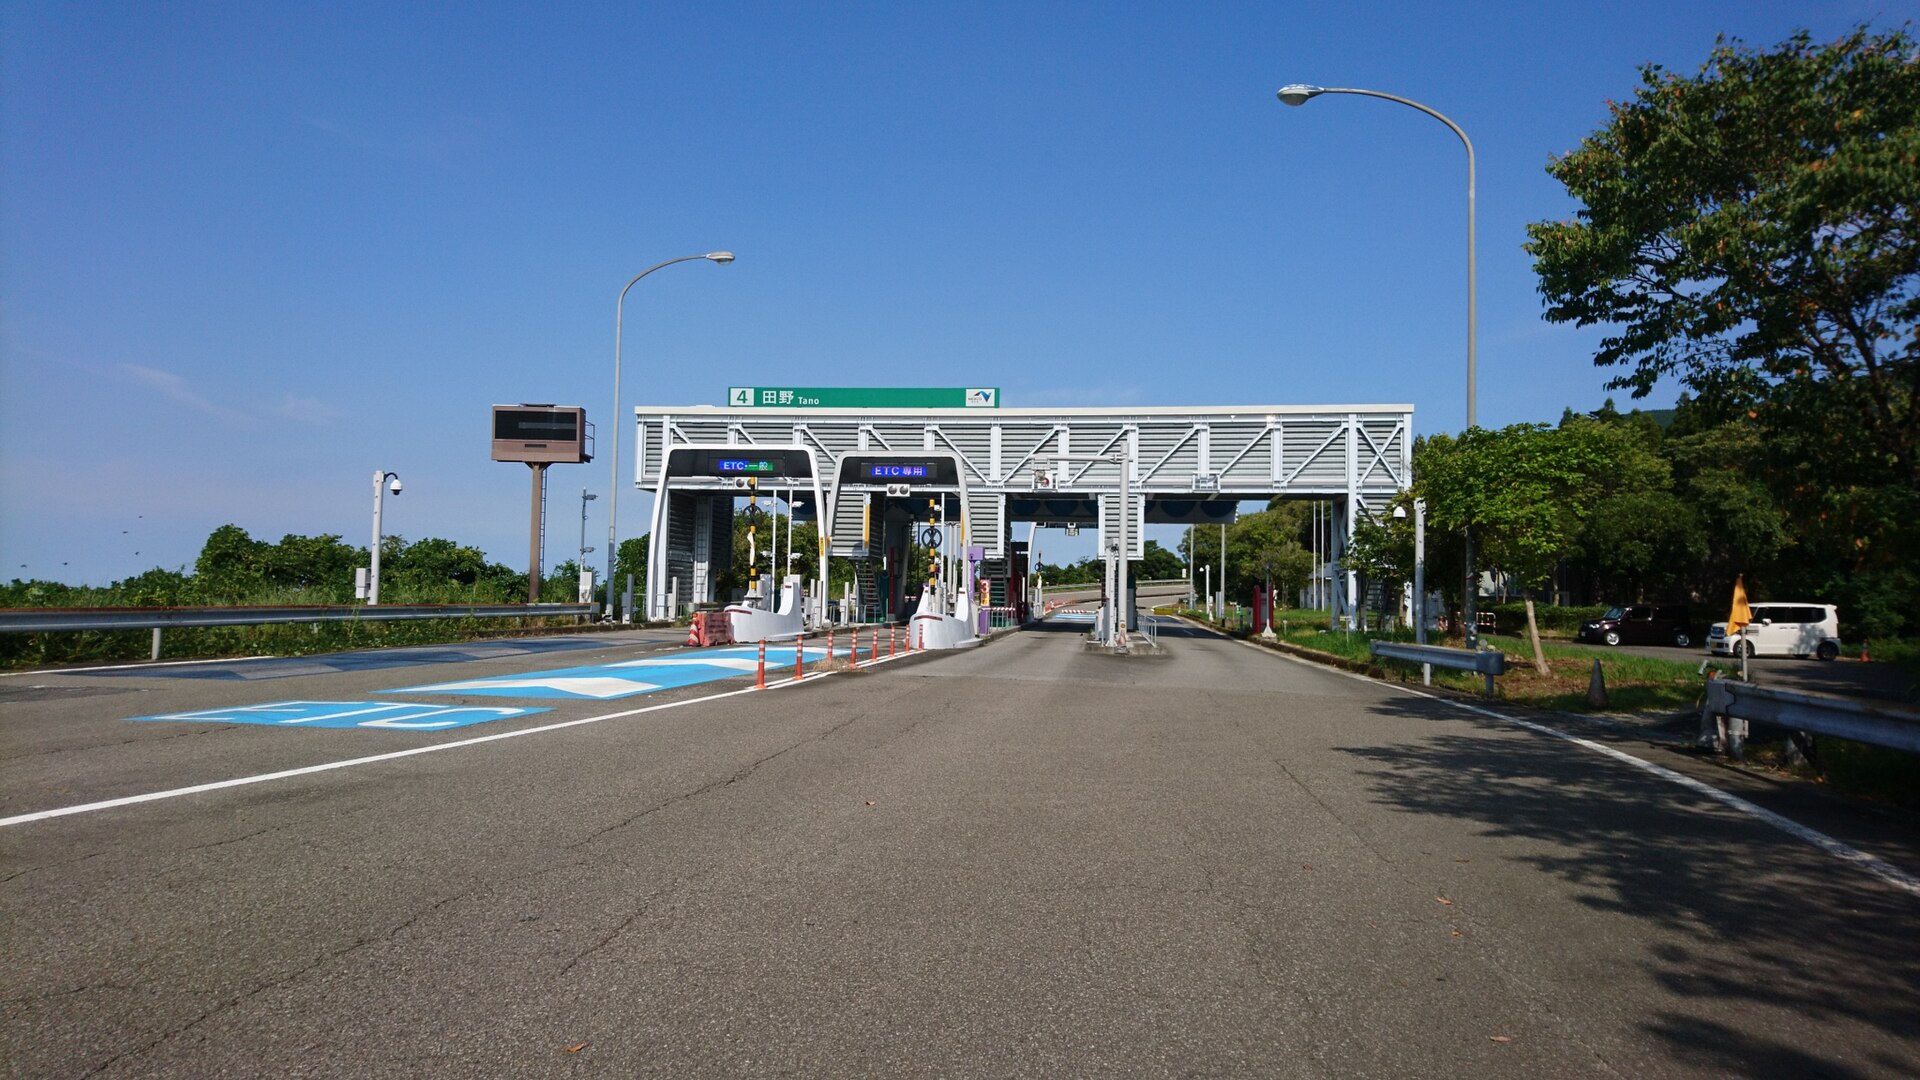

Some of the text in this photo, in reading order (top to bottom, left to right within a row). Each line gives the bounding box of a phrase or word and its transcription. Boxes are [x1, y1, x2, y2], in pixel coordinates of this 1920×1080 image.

[737, 390, 748, 404] 4
[763, 391, 820, 405] 田野 Tano
[980, 580, 989, 594] 3
[153, 701, 526, 728] ETC
